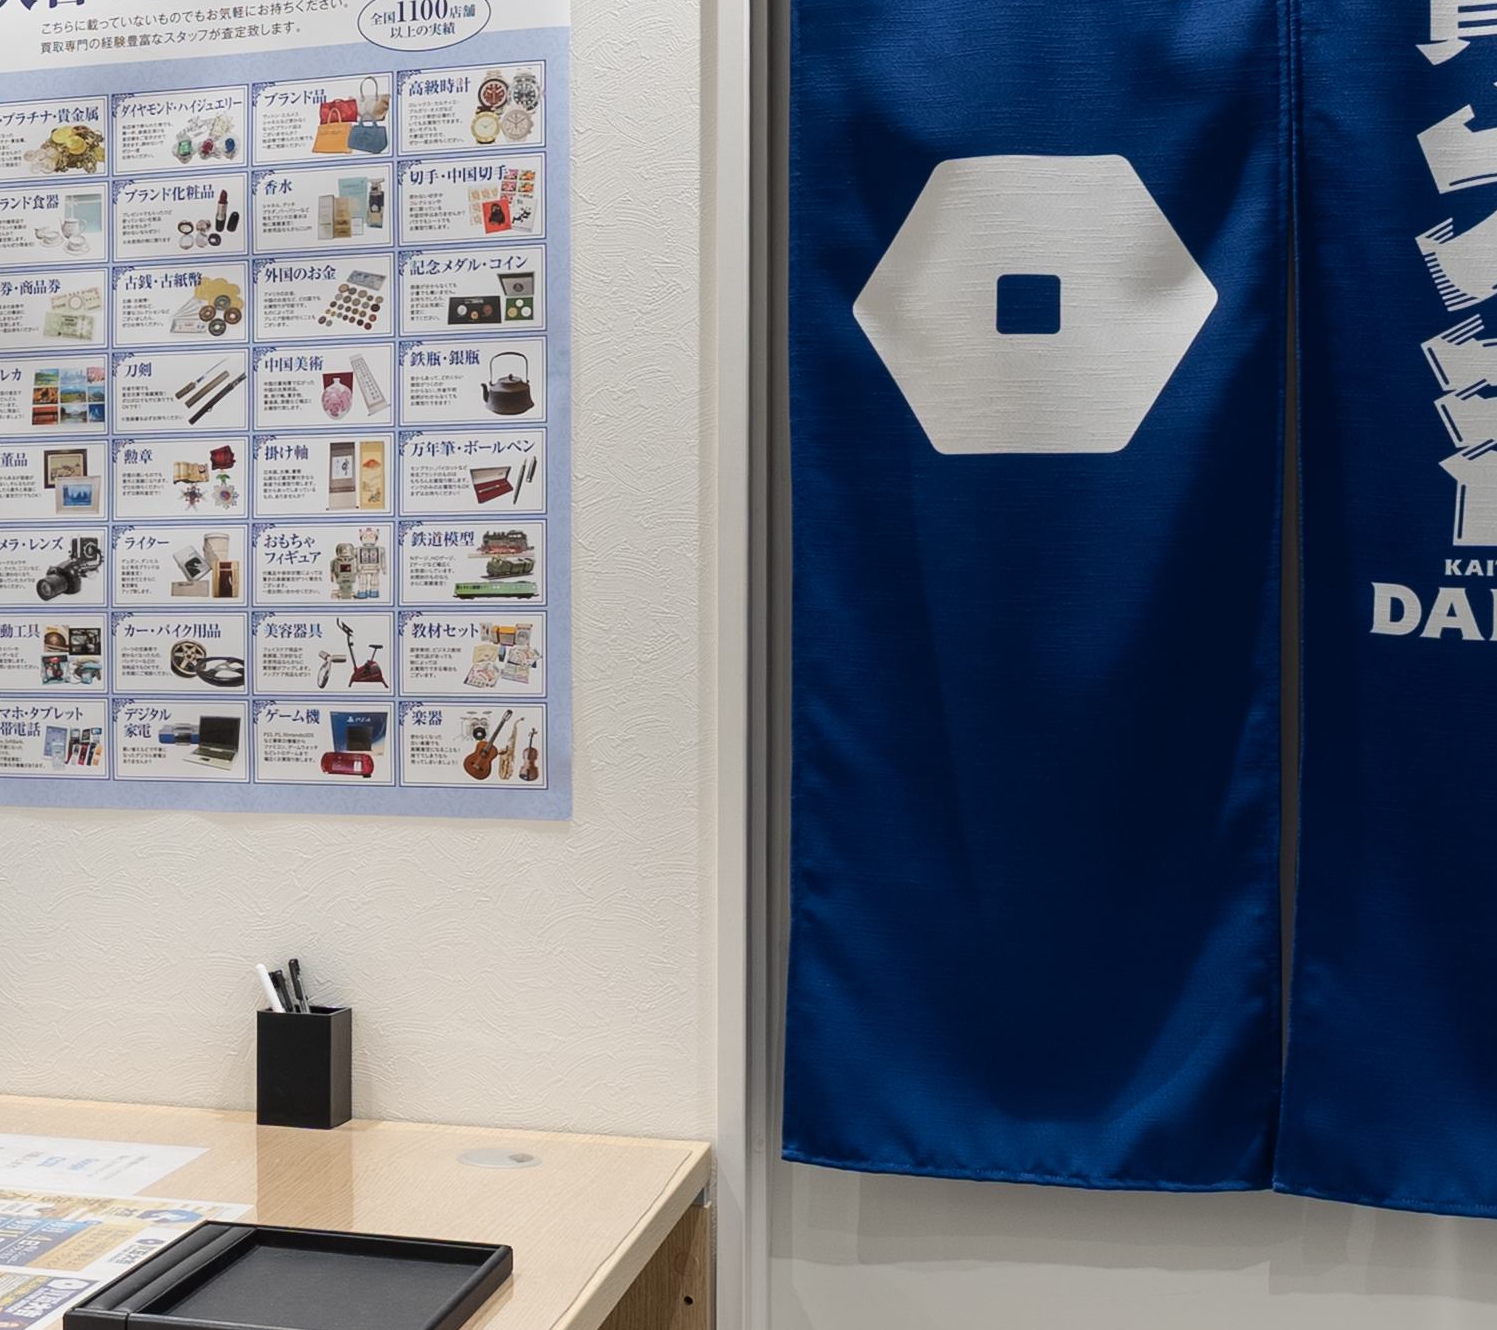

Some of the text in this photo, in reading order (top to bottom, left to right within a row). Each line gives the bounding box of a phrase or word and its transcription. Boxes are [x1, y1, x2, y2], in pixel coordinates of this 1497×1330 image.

[389, 22, 456, 39] 以上の実績
[408, 77, 470, 97] 高級時計
[264, 89, 327, 106] ブランド品
[121, 99, 242, 118] ダイヤモンド・ハイジュエリー
[410, 165, 508, 185] 切手・中国切手
[125, 185, 214, 203] ブランド化粧品
[264, 181, 292, 195] 香水
[410, 255, 528, 276] 記念メダル・コイン
[124, 273, 202, 291] 古銭・古紙幣
[264, 265, 336, 283] 外国のお金
[264, 356, 324, 373] 中国美術
[410, 350, 480, 367] 鉄瓶・銀瓶
[124, 363, 152, 378] 刀剣
[264, 446, 308, 461] 掛け軸
[410, 439, 536, 457] 万年筆・ボールペン
[124, 450, 153, 464] 勲章
[125, 536, 169, 550] ライター
[264, 534, 315, 549] おもちゃ
[411, 531, 474, 548] 鉄道模型
[264, 551, 322, 565] フィギュア
[125, 624, 221, 639] カー・バイク用品
[264, 623, 322, 639] 美容器具
[412, 623, 479, 639] 教材セット
[124, 708, 171, 721] デジタル
[264, 710, 320, 725] ゲーム機
[412, 711, 442, 726] 楽器
[123, 724, 151, 738] 家電
